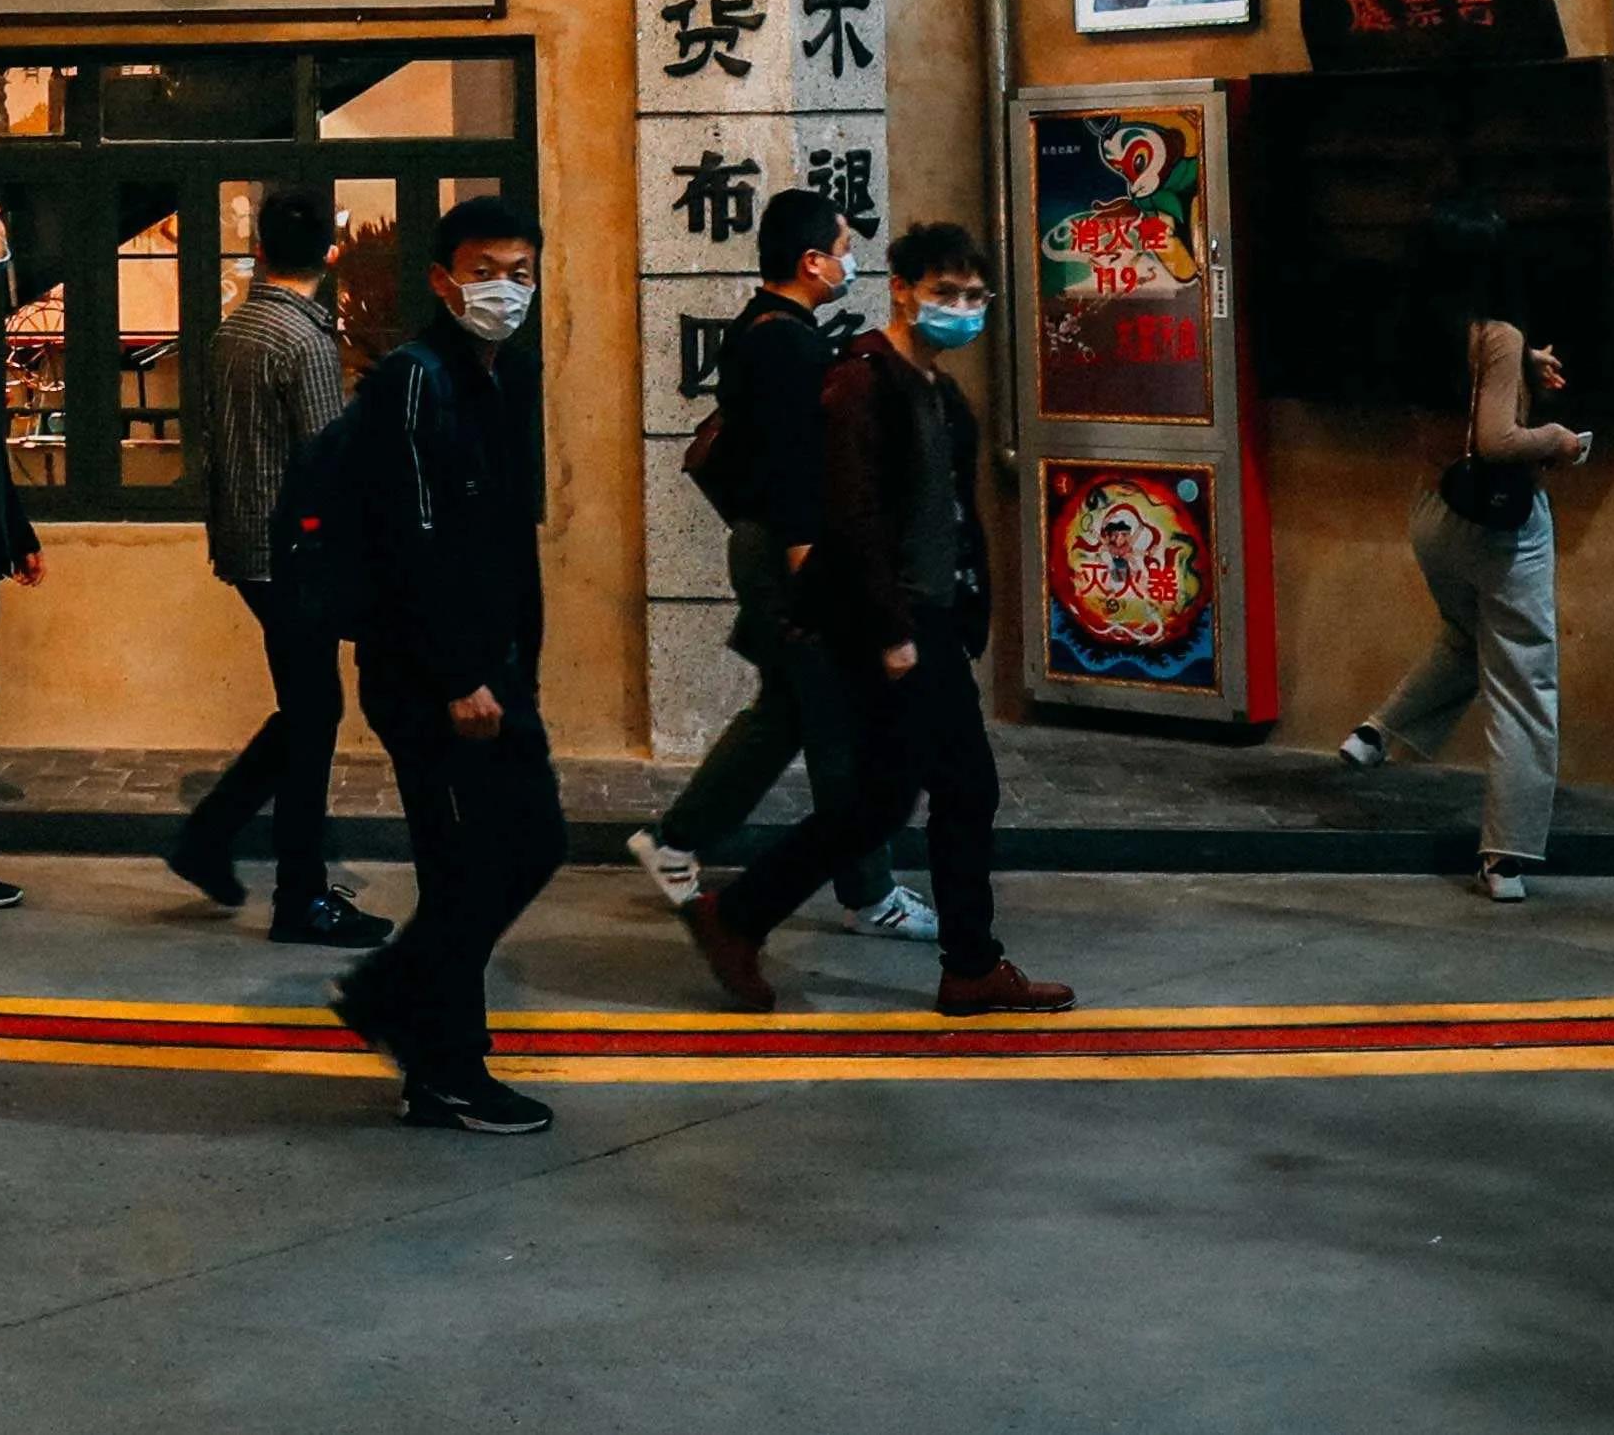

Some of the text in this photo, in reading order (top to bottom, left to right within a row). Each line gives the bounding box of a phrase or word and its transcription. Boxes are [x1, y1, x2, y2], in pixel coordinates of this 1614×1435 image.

[1070, 216, 1171, 251] 消火栓
[1094, 266, 1138, 294] 119
[1075, 563, 1178, 602] 灭火器
